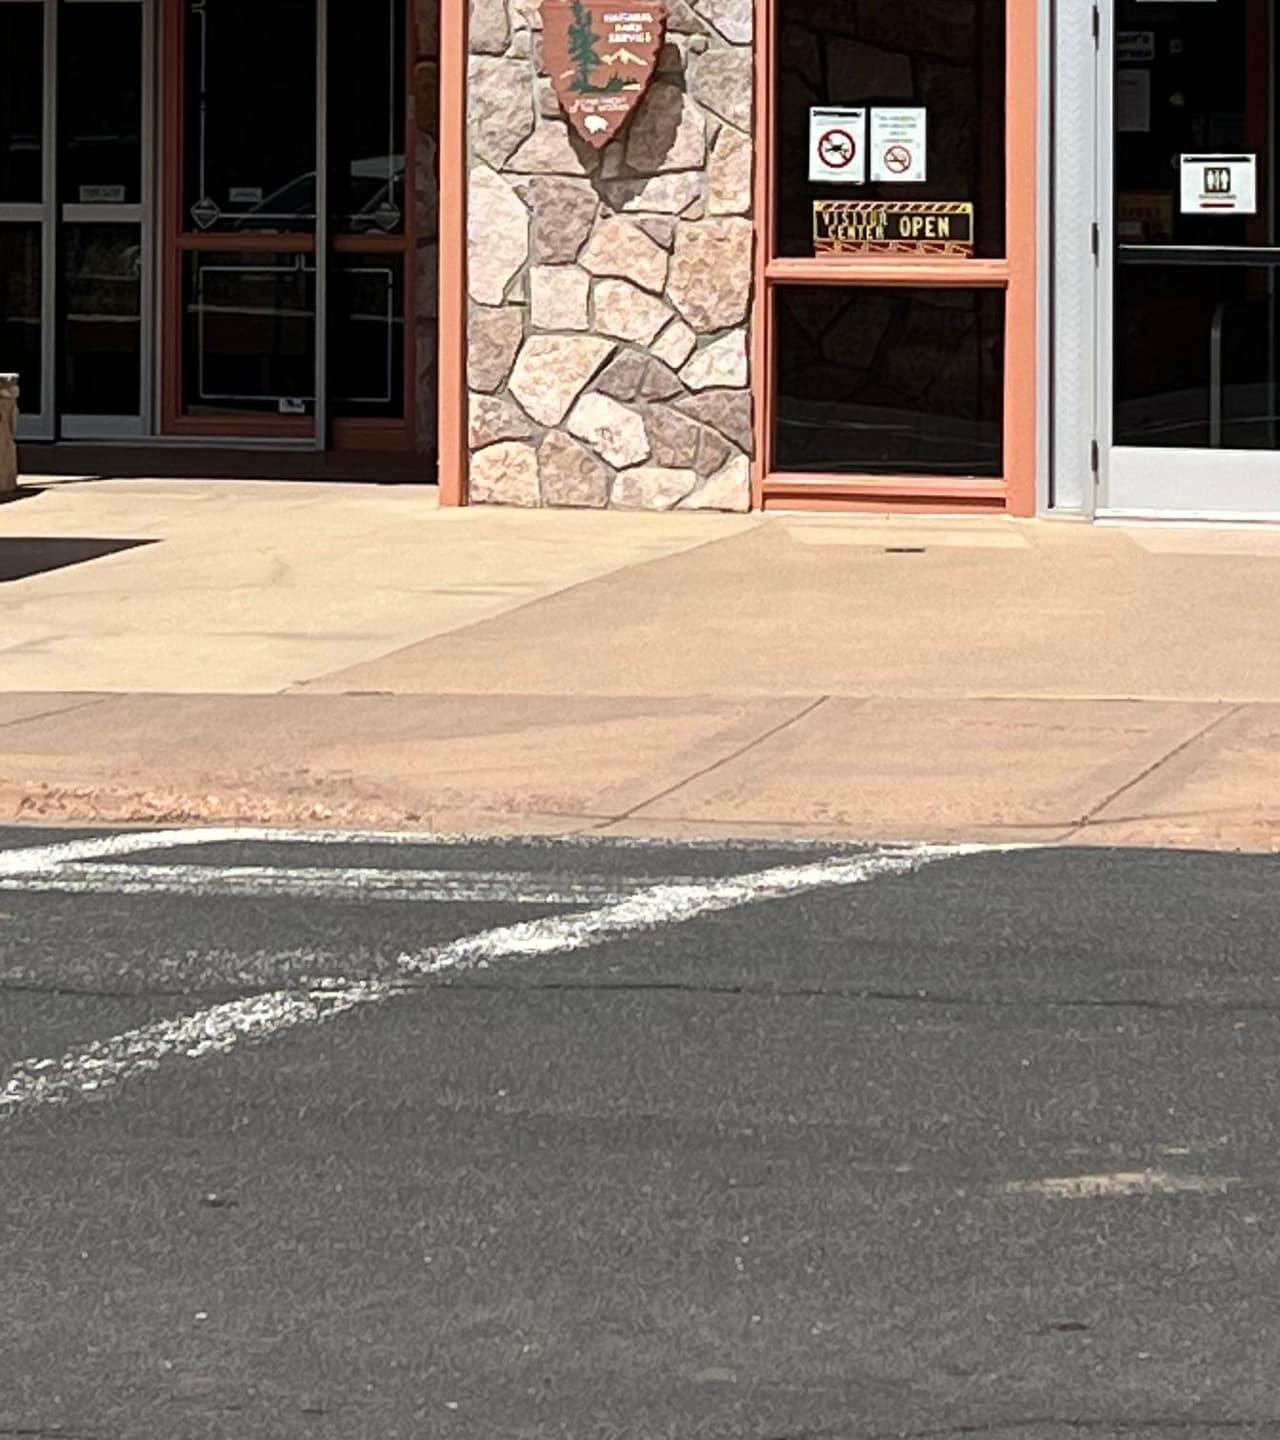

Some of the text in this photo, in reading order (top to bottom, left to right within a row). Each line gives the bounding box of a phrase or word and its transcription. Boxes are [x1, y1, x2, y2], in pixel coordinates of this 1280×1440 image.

[822, 210, 888, 226] VISITOR
[828, 225, 884, 241] CENTER
[899, 215, 951, 238] OPEN
